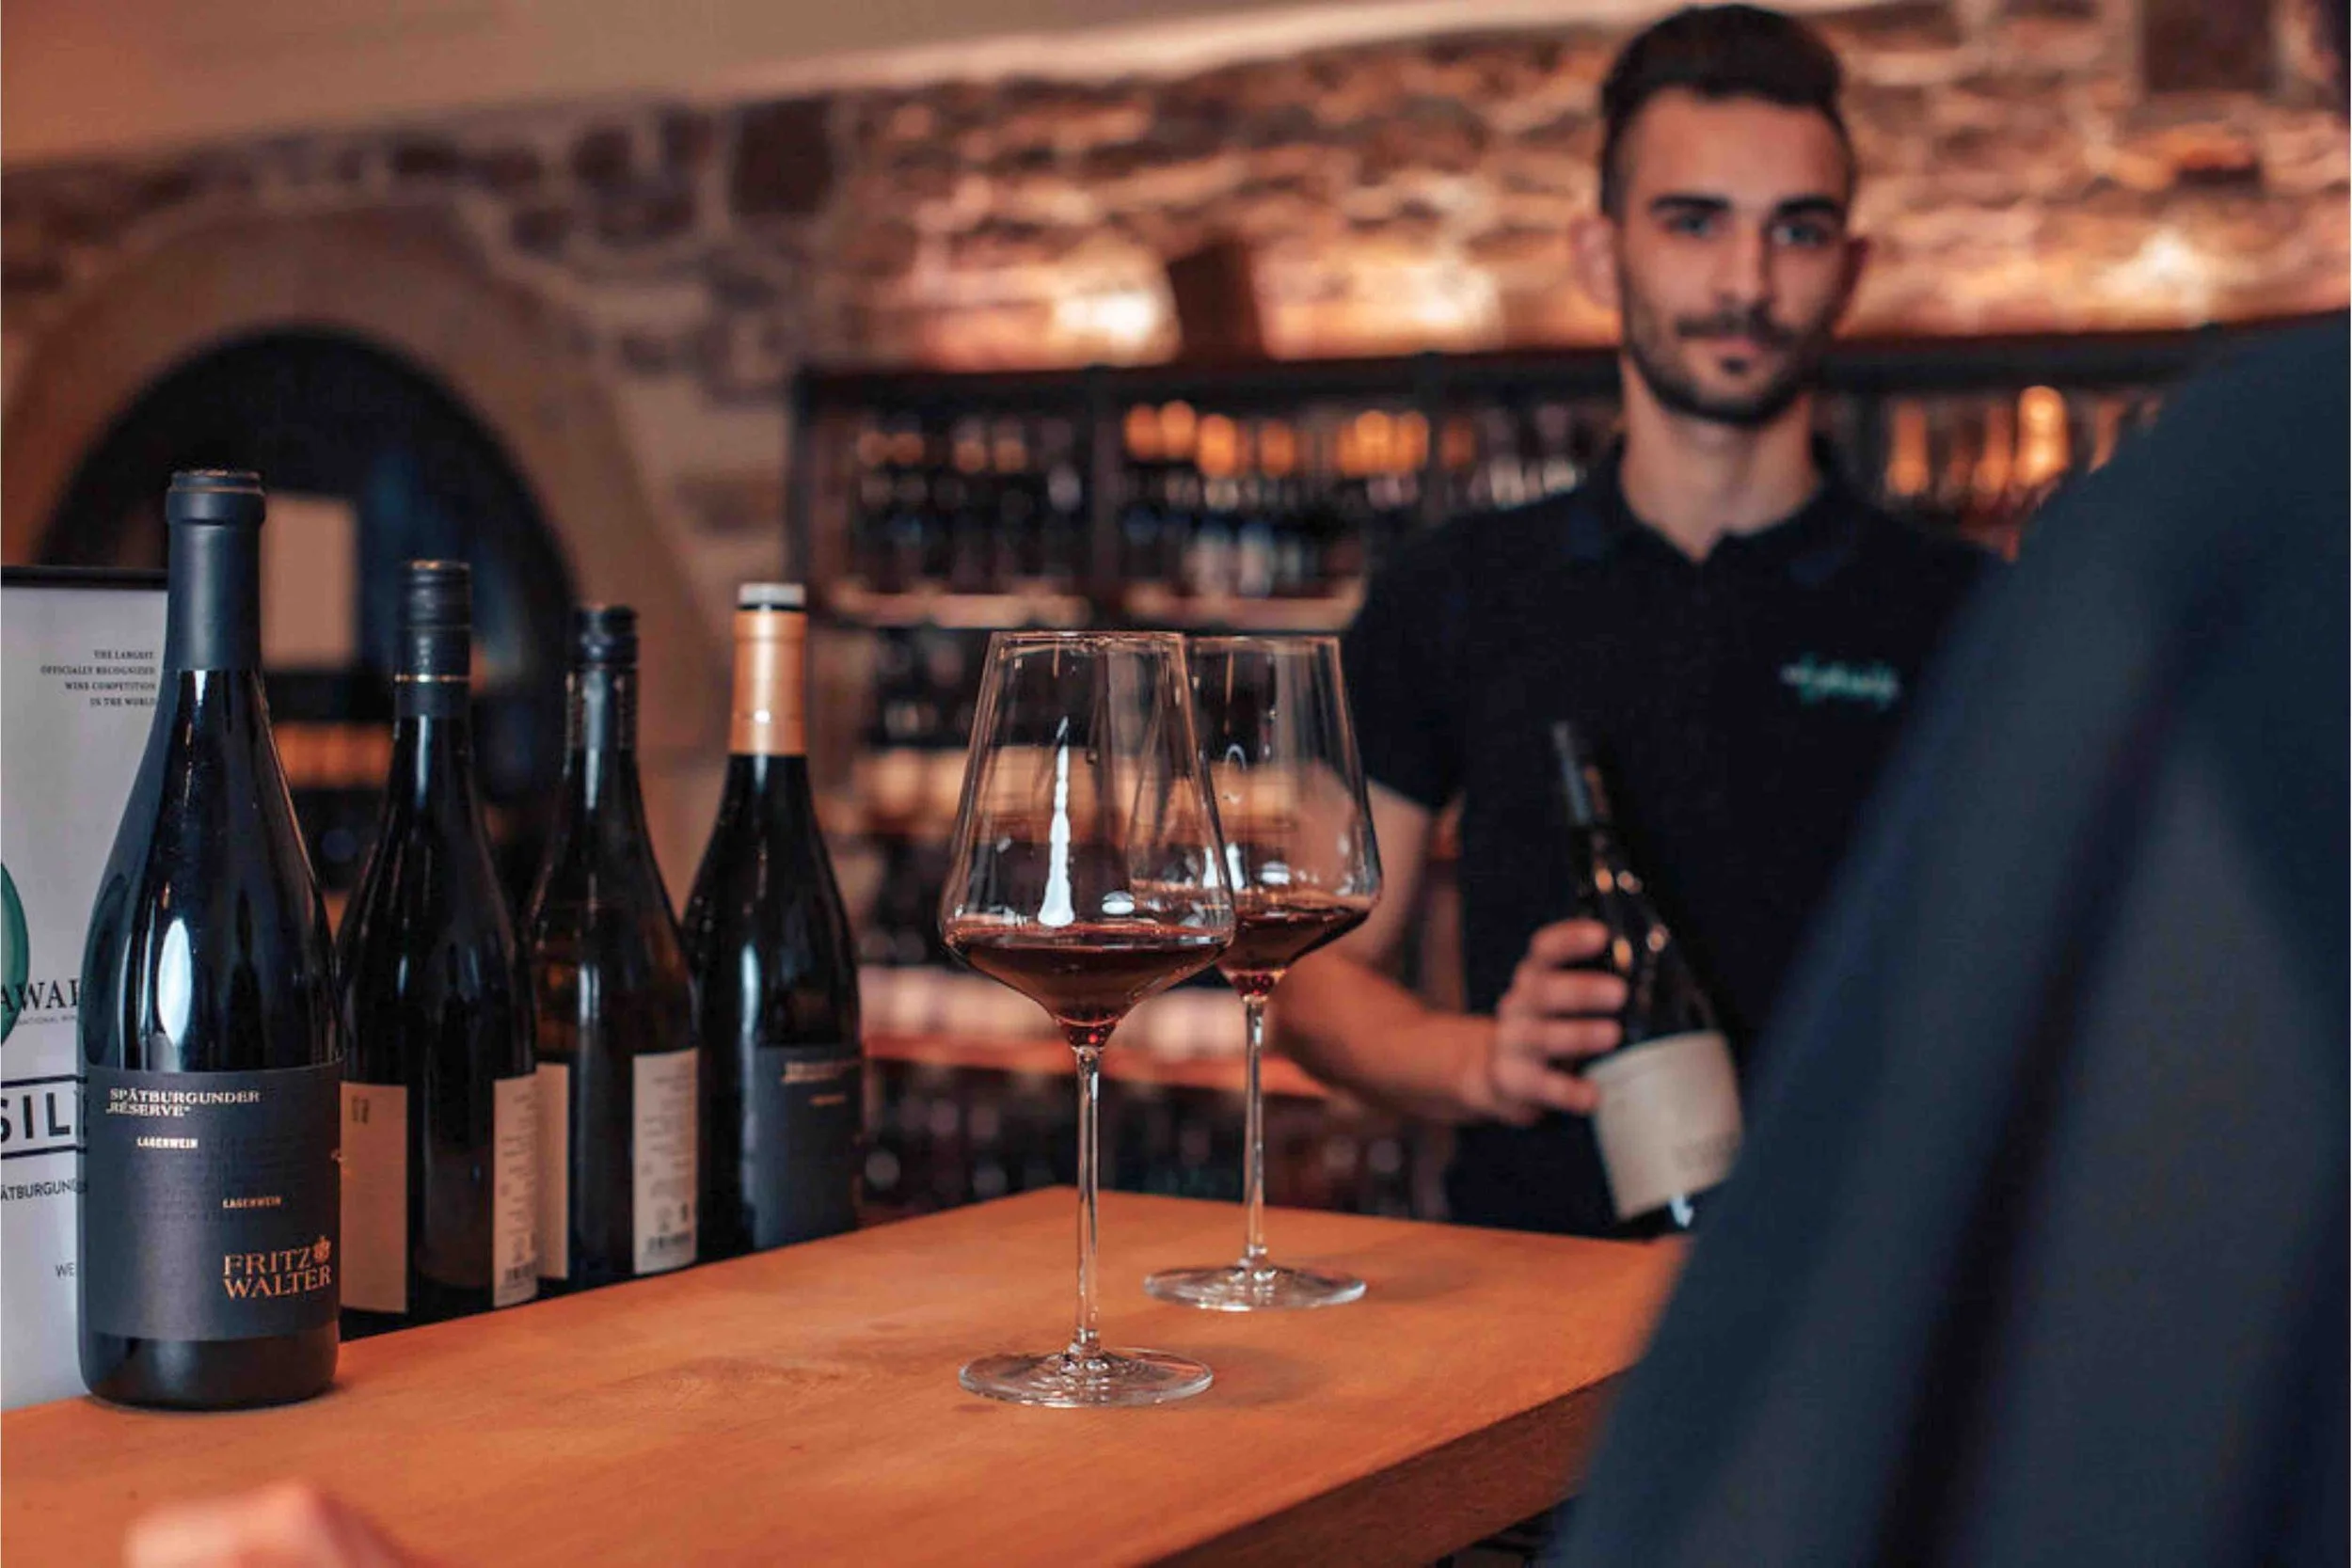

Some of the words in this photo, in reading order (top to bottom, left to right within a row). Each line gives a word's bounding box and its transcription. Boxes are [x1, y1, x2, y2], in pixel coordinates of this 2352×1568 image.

[93, 649, 112, 660] THE
[115, 650, 154, 660] LARGEST
[40, 664, 94, 675] OFFICIALLY
[64, 681, 89, 691] WINE
[91, 681, 156, 691] COMPETITION
[103, 697, 122, 707] THE
[109, 1086, 261, 1105] SPÄTBURGUNDER
[223, 1246, 310, 1276] FRITZ
[223, 1264, 332, 1300] WALTER
